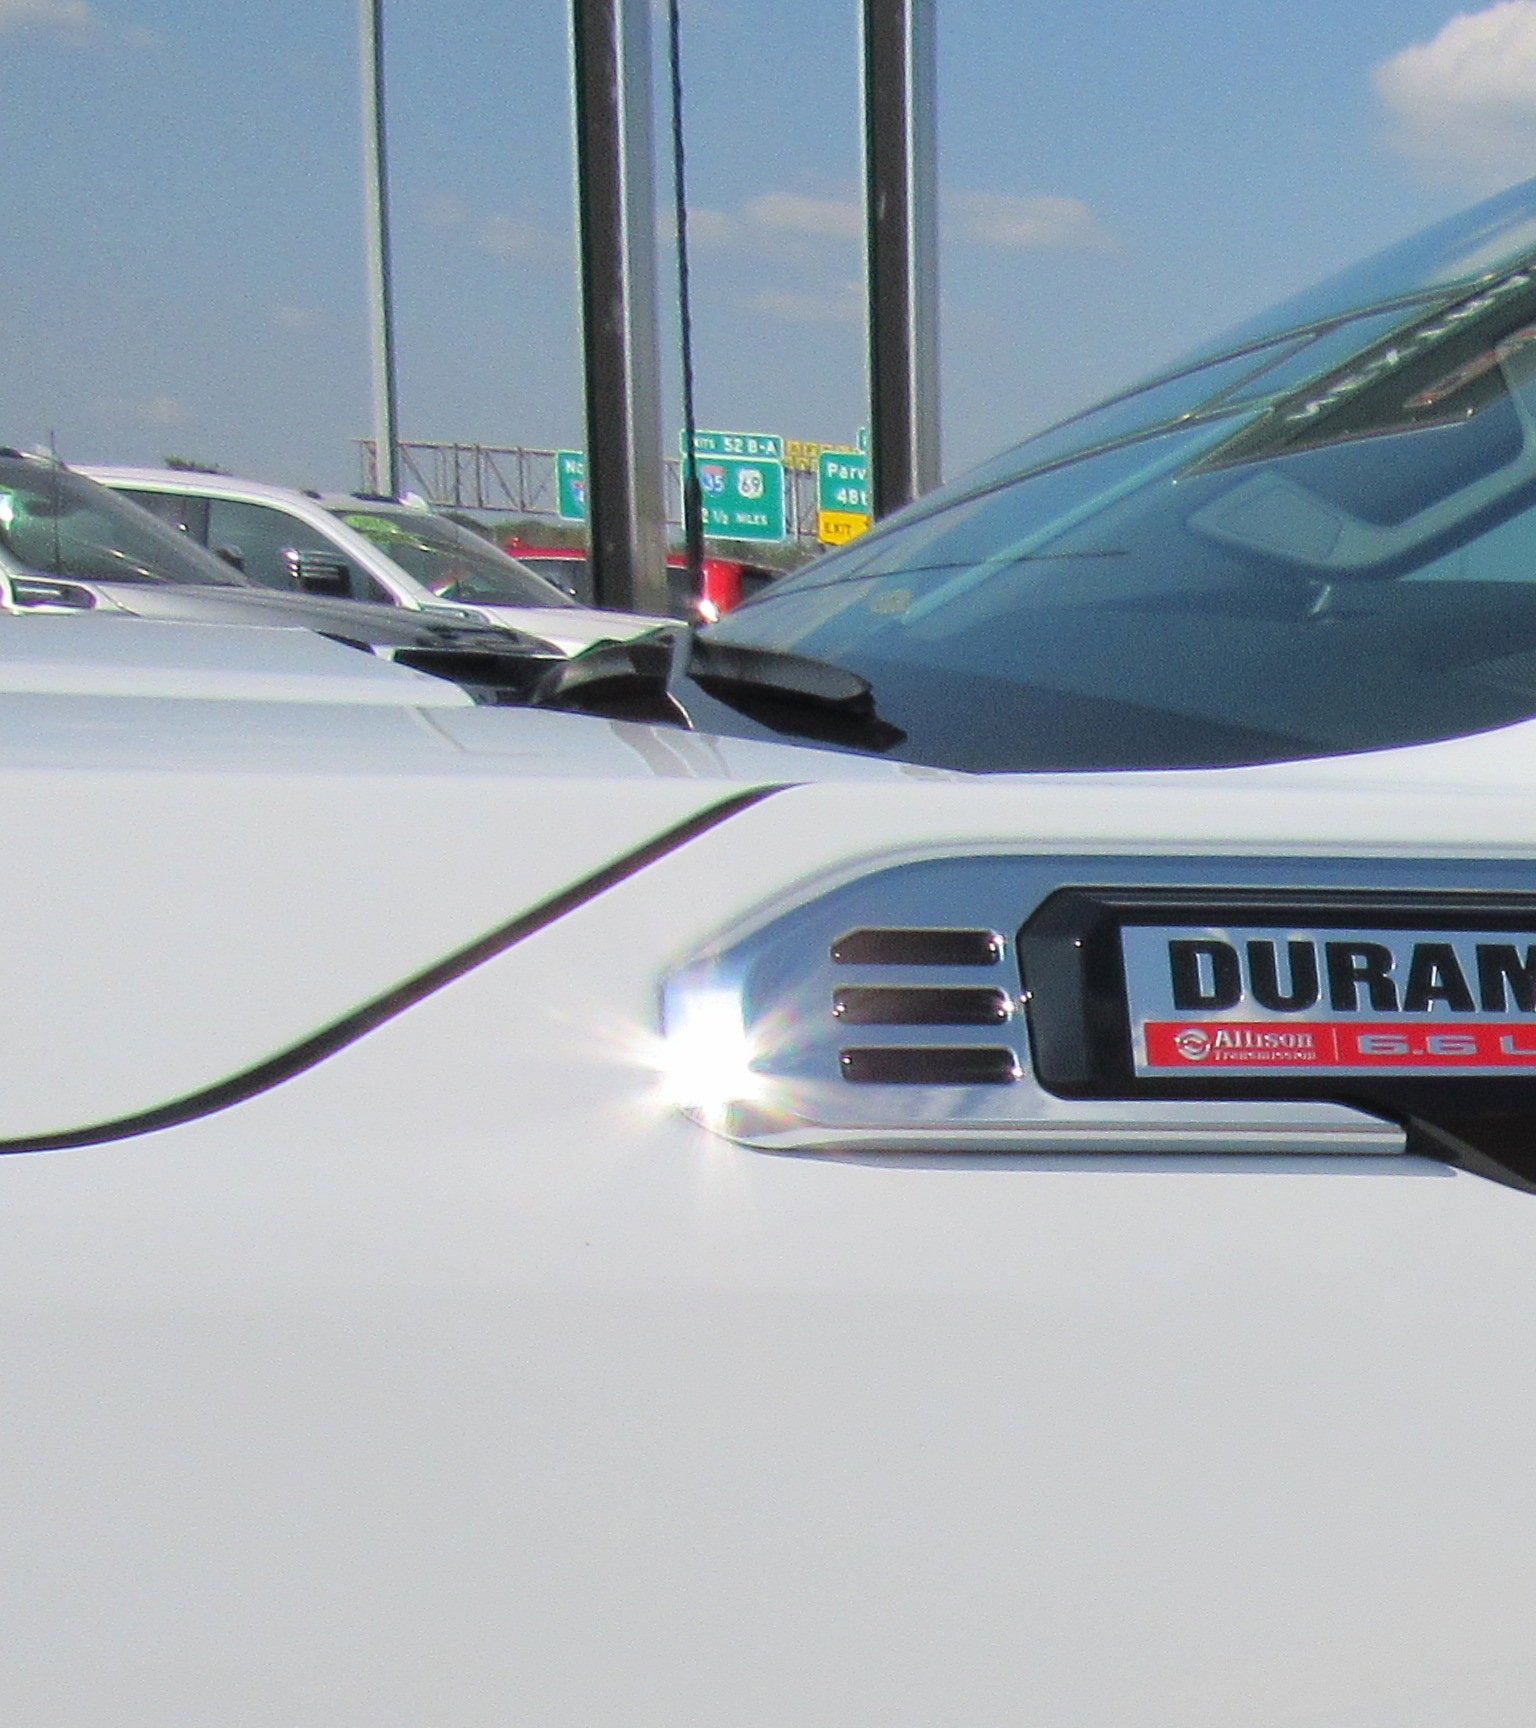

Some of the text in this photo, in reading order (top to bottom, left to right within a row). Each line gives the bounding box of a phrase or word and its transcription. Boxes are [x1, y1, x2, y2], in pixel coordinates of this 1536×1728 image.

[723, 437, 744, 453] 52
[741, 476, 760, 493] 69
[1215, 1030, 1314, 1048] Allison
[1357, 1034, 1486, 1056] 6.6
